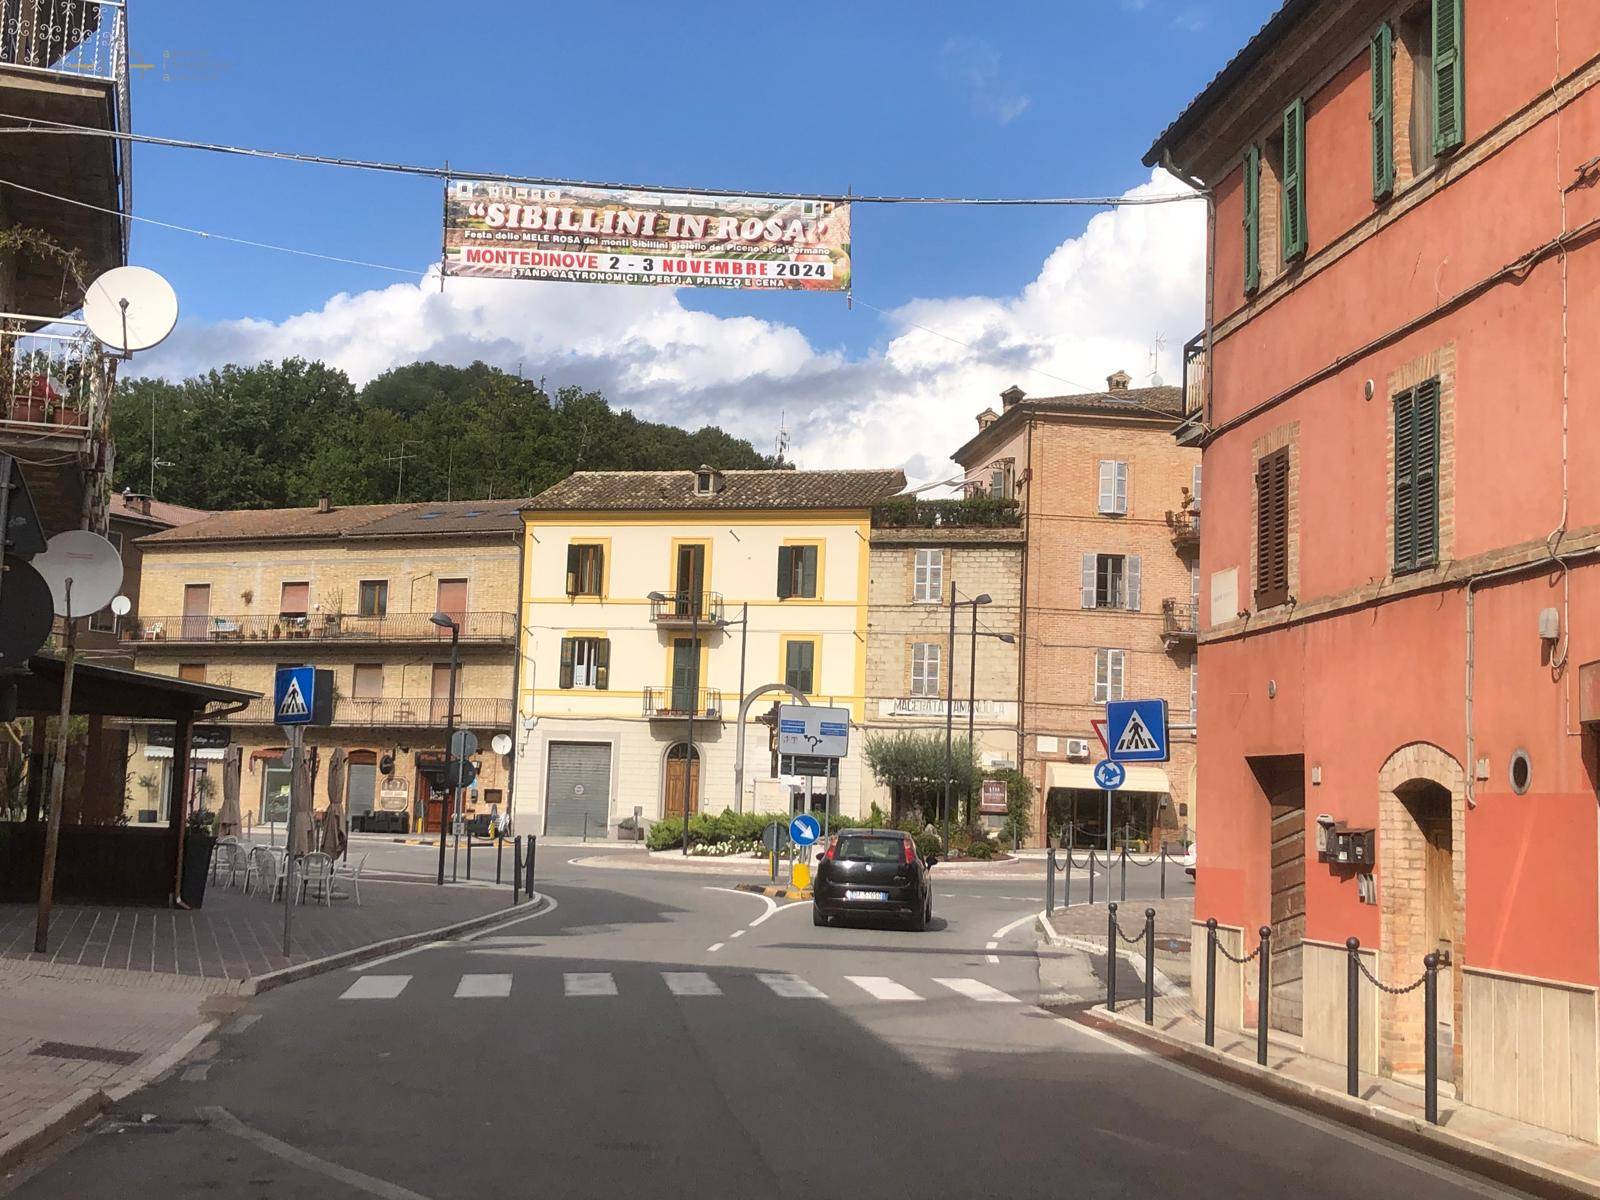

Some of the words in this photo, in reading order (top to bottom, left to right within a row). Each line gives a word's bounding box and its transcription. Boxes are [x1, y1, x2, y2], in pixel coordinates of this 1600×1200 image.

[666, 213, 709, 238] IN
[464, 231, 492, 240] Festa
[495, 233, 520, 241] delle
[522, 233, 550, 243] MELE
[552, 235, 581, 244] ROSA
[583, 237, 599, 245] dei
[600, 238, 629, 247] monti
[631, 239, 668, 249] Sibillini
[671, 241, 706, 252] gioiello
[709, 243, 724, 252] del
[726, 244, 760, 253] Piceno
[787, 246, 830, 255] Fermano
[466, 249, 599, 269] MONTEDINOVE
[609, 256, 620, 270] 2
[642, 257, 654, 272] 3
[662, 259, 768, 276] NOVEMBRE
[776, 263, 826, 277] 2024
[511, 268, 548, 279] STAND
[551, 270, 638, 283] GASTRONOMICI
[641, 273, 682, 285] APERTI
[684, 276, 694, 285] A
[696, 277, 742, 288] PRANZO
[744, 278, 752, 287] E
[755, 278, 785, 288] CENA
[893, 699, 945, 713] MACERATA
